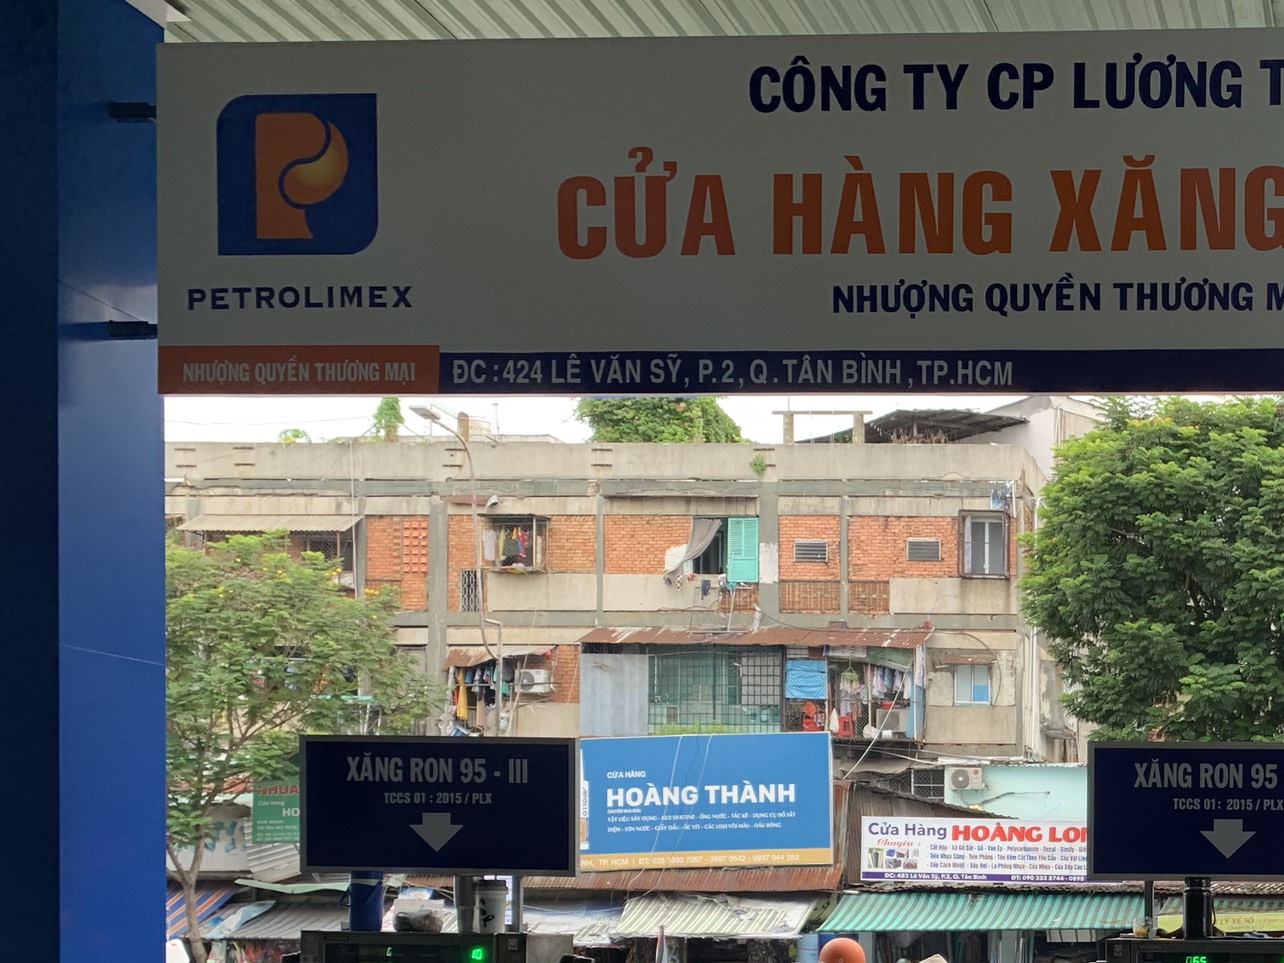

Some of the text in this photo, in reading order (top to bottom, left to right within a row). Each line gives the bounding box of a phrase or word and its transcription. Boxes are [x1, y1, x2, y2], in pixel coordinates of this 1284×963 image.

[749, 55, 886, 113] CÔNG
[903, 64, 968, 110] TY
[987, 63, 1054, 110] CP
[1074, 53, 1242, 109] LƯƠNG
[557, 146, 735, 260] CỬA
[773, 155, 1012, 255] HÀNG
[187, 285, 412, 310] PETROLIMEX
[833, 279, 973, 319] NHƯỢNG
[985, 272, 1100, 317] QUYỀN
[1113, 277, 1253, 311] THƯƠNG
[183, 355, 415, 385] NHƯỢNG QUYỀN THƯƠNG MẠI
[552, 353, 581, 383] LÊ
[591, 355, 640, 383] VĂN
[651, 354, 690, 387] SỸ,
[843, 352, 900, 384] BÌNH
[347, 750, 528, 784] XĂNG RON 95 III
[607, 770, 646, 779] CỬA HÀNG
[1134, 756, 1192, 789] XĂNG
[1200, 763, 1243, 789] RON
[1251, 763, 1277, 789] 95
[384, 792, 410, 804] TCCS
[436, 792, 462, 804] 2015
[472, 792, 492, 804] PLX
[607, 780, 796, 807] HOÀNG THÀNH
[1173, 798, 1200, 811] TCCS
[1227, 798, 1253, 811] 2015
[1263, 798, 1284, 811] PLX
[868, 822, 899, 836] Cửa
[904, 823, 947, 840] Hàng
[952, 822, 1043, 843] HOÀNG
[611, 858, 629, 866] HCM
[686, 855, 703, 863] 7097
[786, 853, 800, 861] 282
[472, 948, 483, 960] 10
